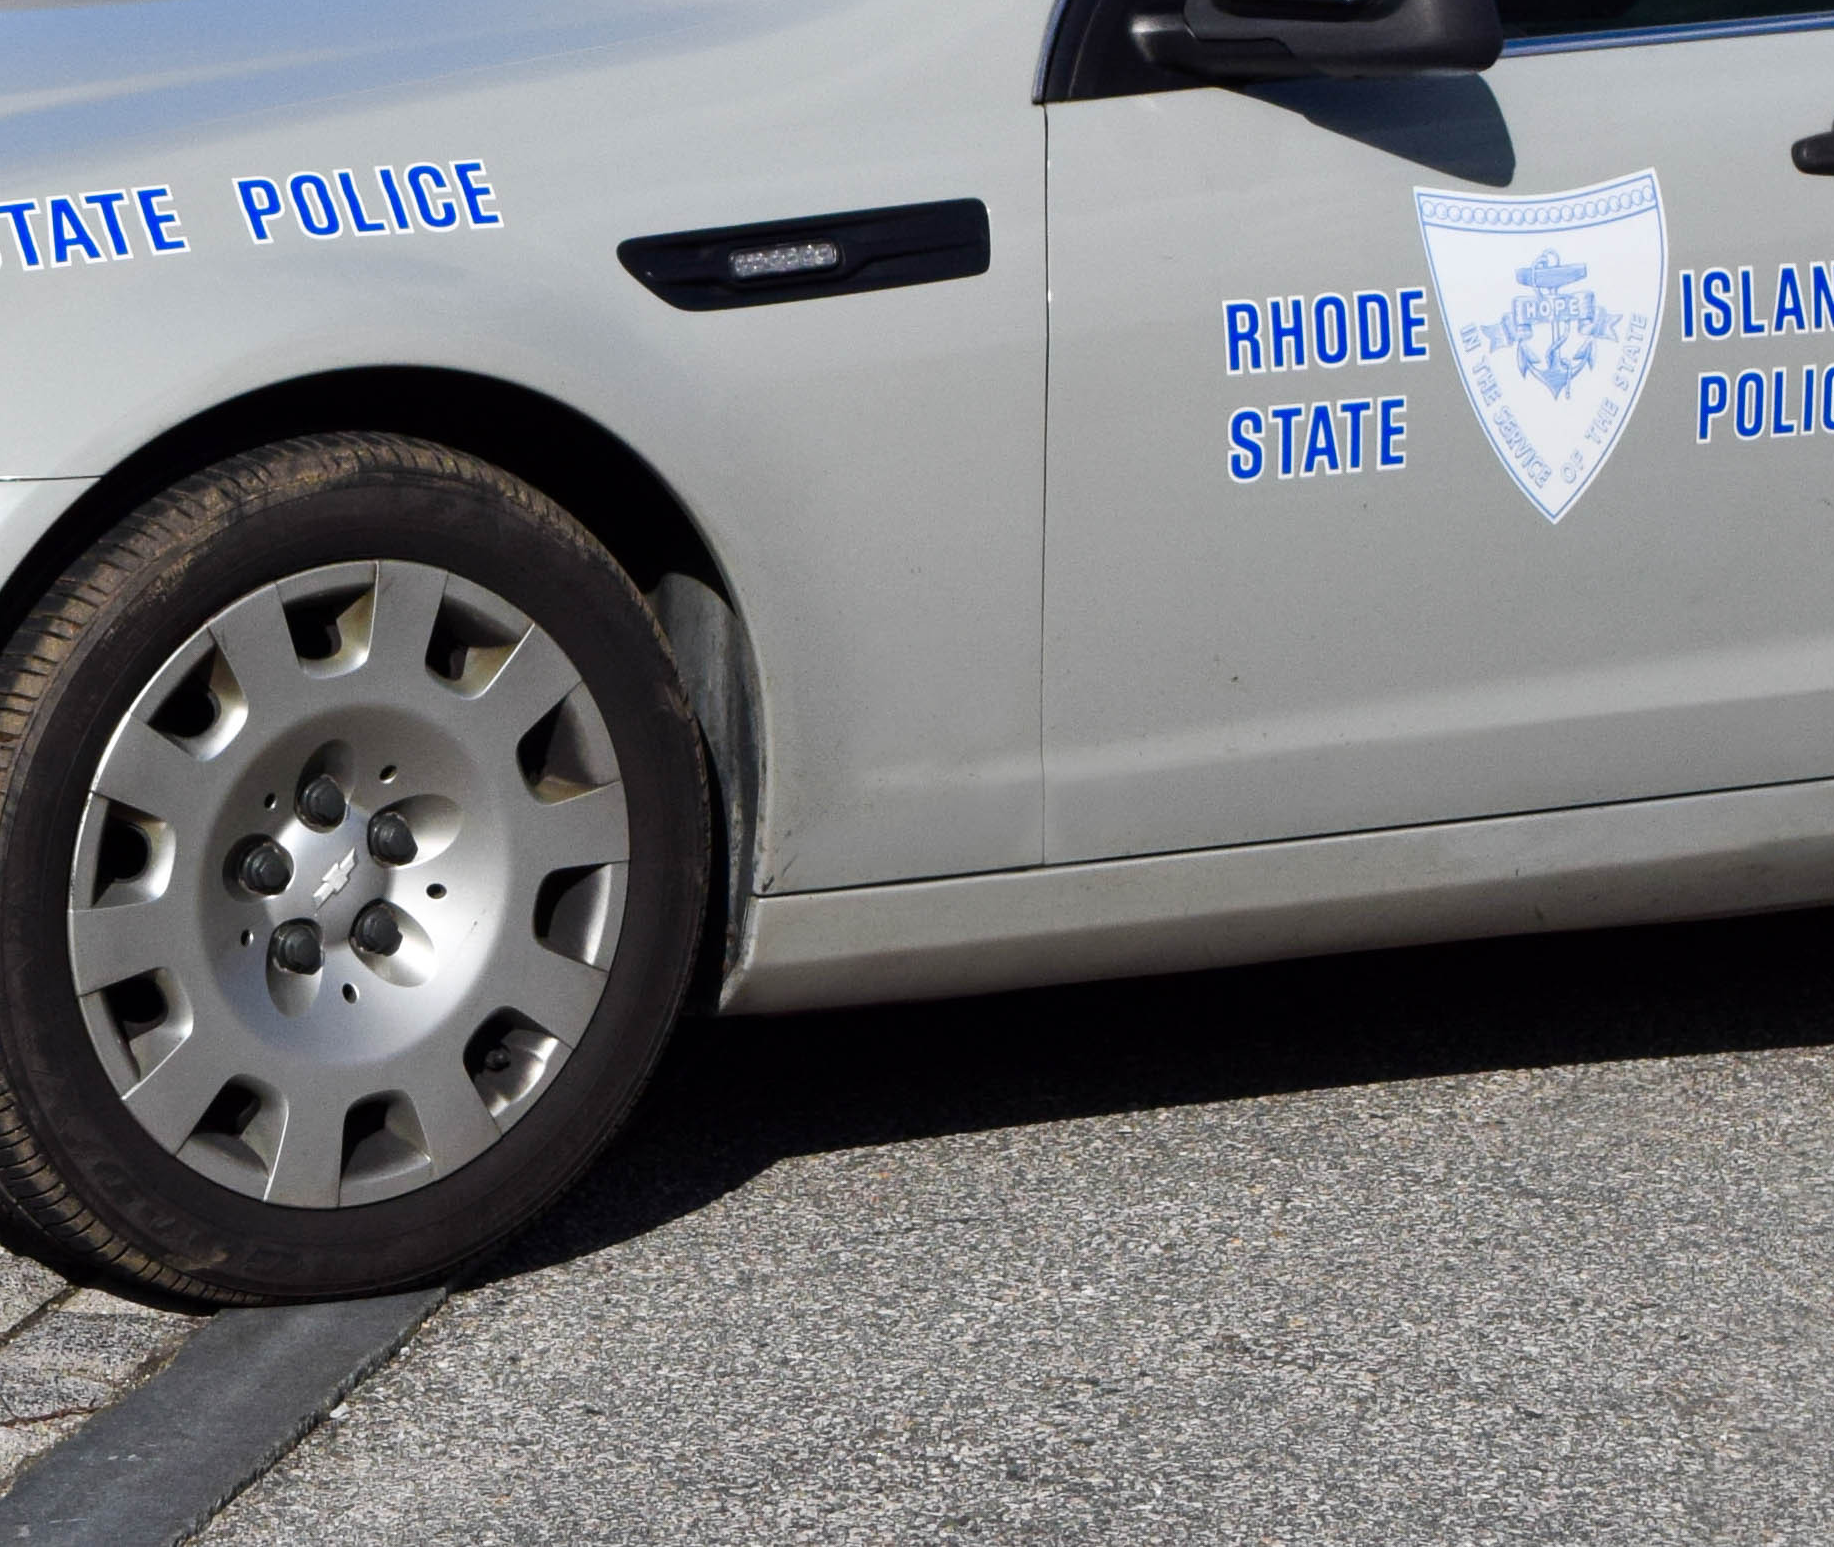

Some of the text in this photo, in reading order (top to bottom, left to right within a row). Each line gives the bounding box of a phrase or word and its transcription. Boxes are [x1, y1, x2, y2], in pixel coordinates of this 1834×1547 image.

[232, 159, 504, 244] POLICE
[1222, 286, 1430, 375] RHODE
[1526, 298, 1581, 318] HOPE
[1227, 395, 1408, 484] STATE
[1460, 313, 1648, 489] IN THE SERVICE OF THE STATE
